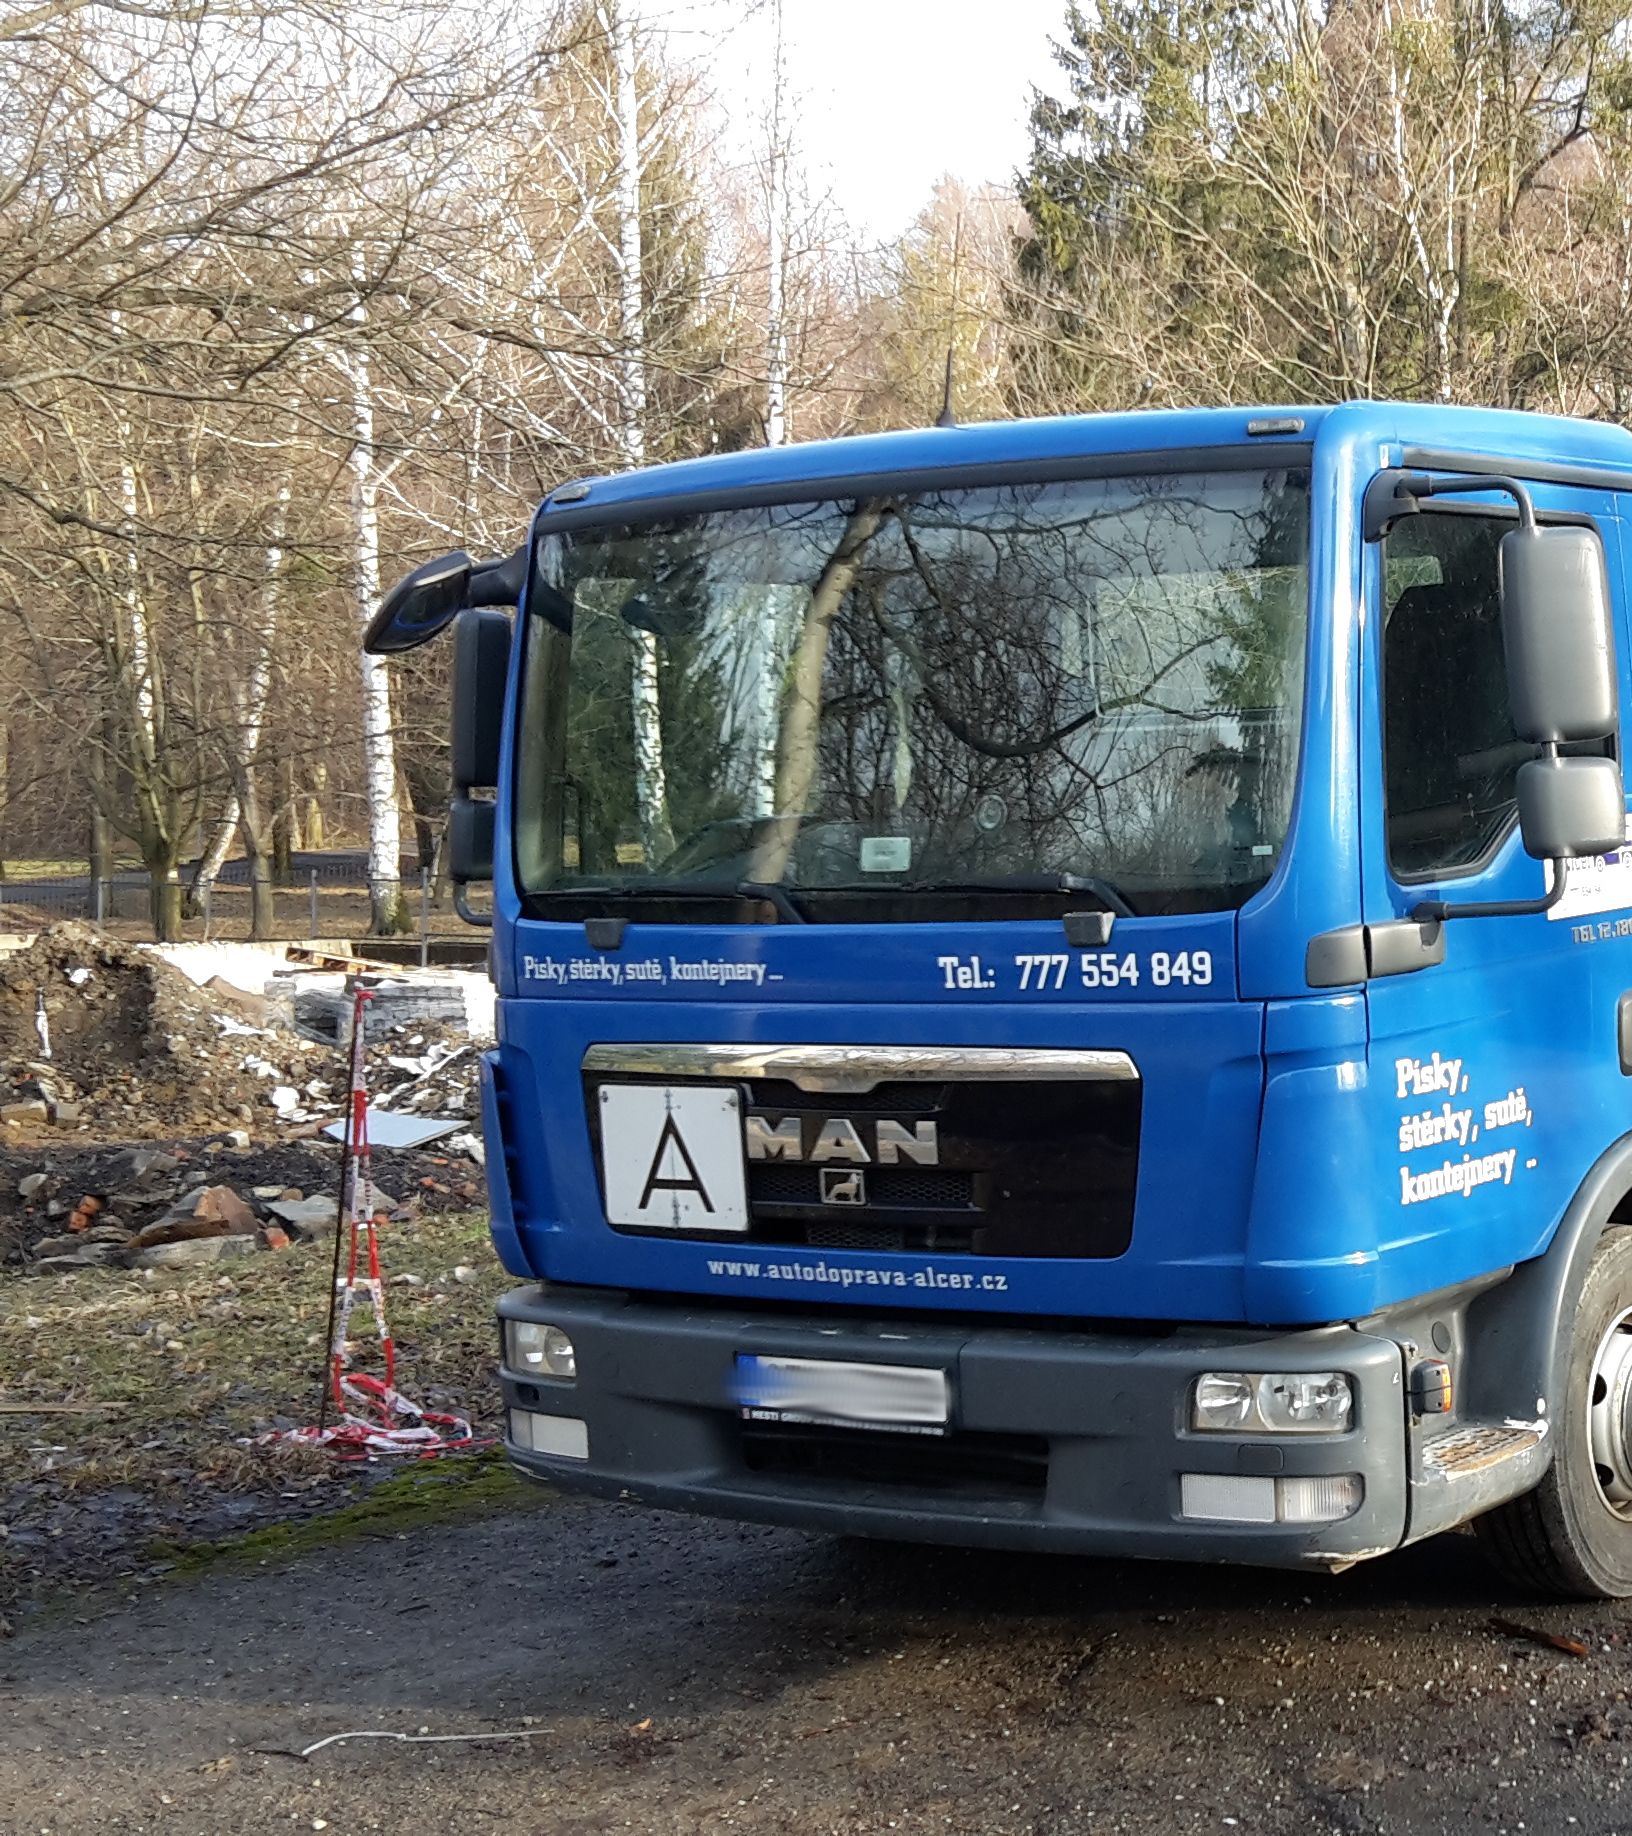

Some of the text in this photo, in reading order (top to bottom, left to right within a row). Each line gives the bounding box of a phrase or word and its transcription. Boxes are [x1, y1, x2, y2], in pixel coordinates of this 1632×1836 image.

[1571, 924, 1597, 944] TGL
[669, 956, 767, 986] kontejnery
[938, 951, 1212, 989] Tel.: 777 554 849
[1395, 1051, 1469, 1099] Písky,
[745, 1116, 938, 1165] MAN
[1400, 1087, 1533, 1153] štěrky, sutě,
[637, 1113, 717, 1214] A
[1400, 1148, 1517, 1206] kontejnery
[707, 1259, 1008, 1291] www.autodoprava-alcer.cz
